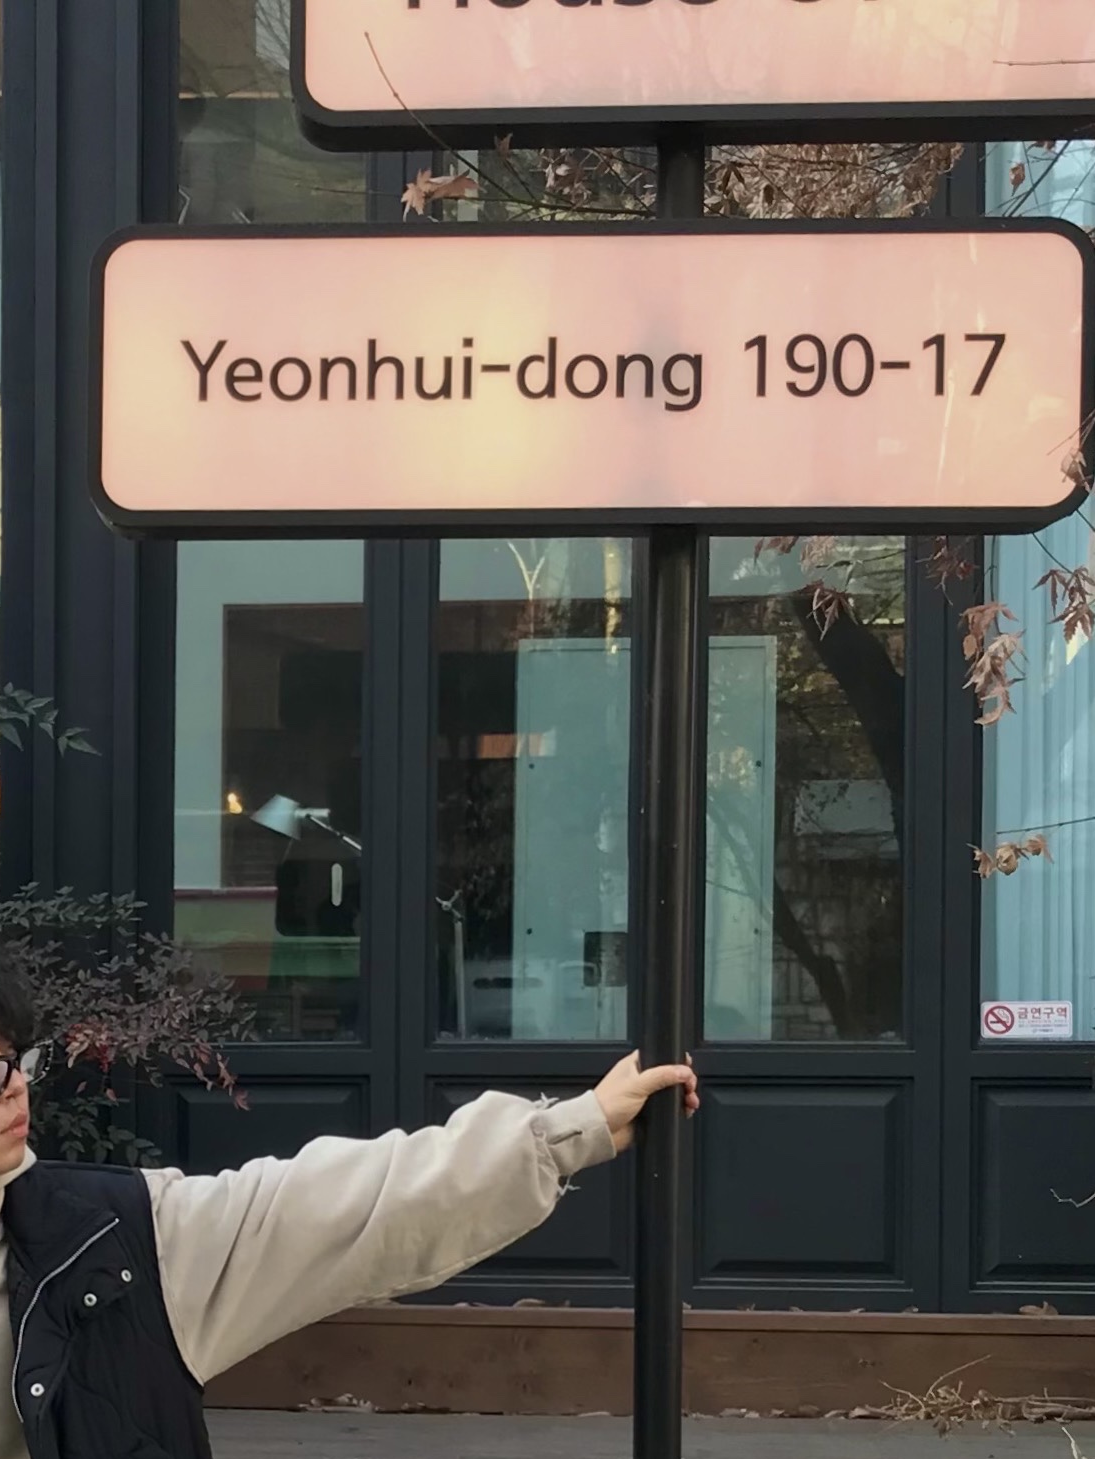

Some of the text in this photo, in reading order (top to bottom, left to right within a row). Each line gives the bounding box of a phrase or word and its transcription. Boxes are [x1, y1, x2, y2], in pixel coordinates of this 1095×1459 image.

[181, 333, 1005, 411] Yeonhui-dong 190-17
[1017, 1007, 1067, 1020] 금연구역
